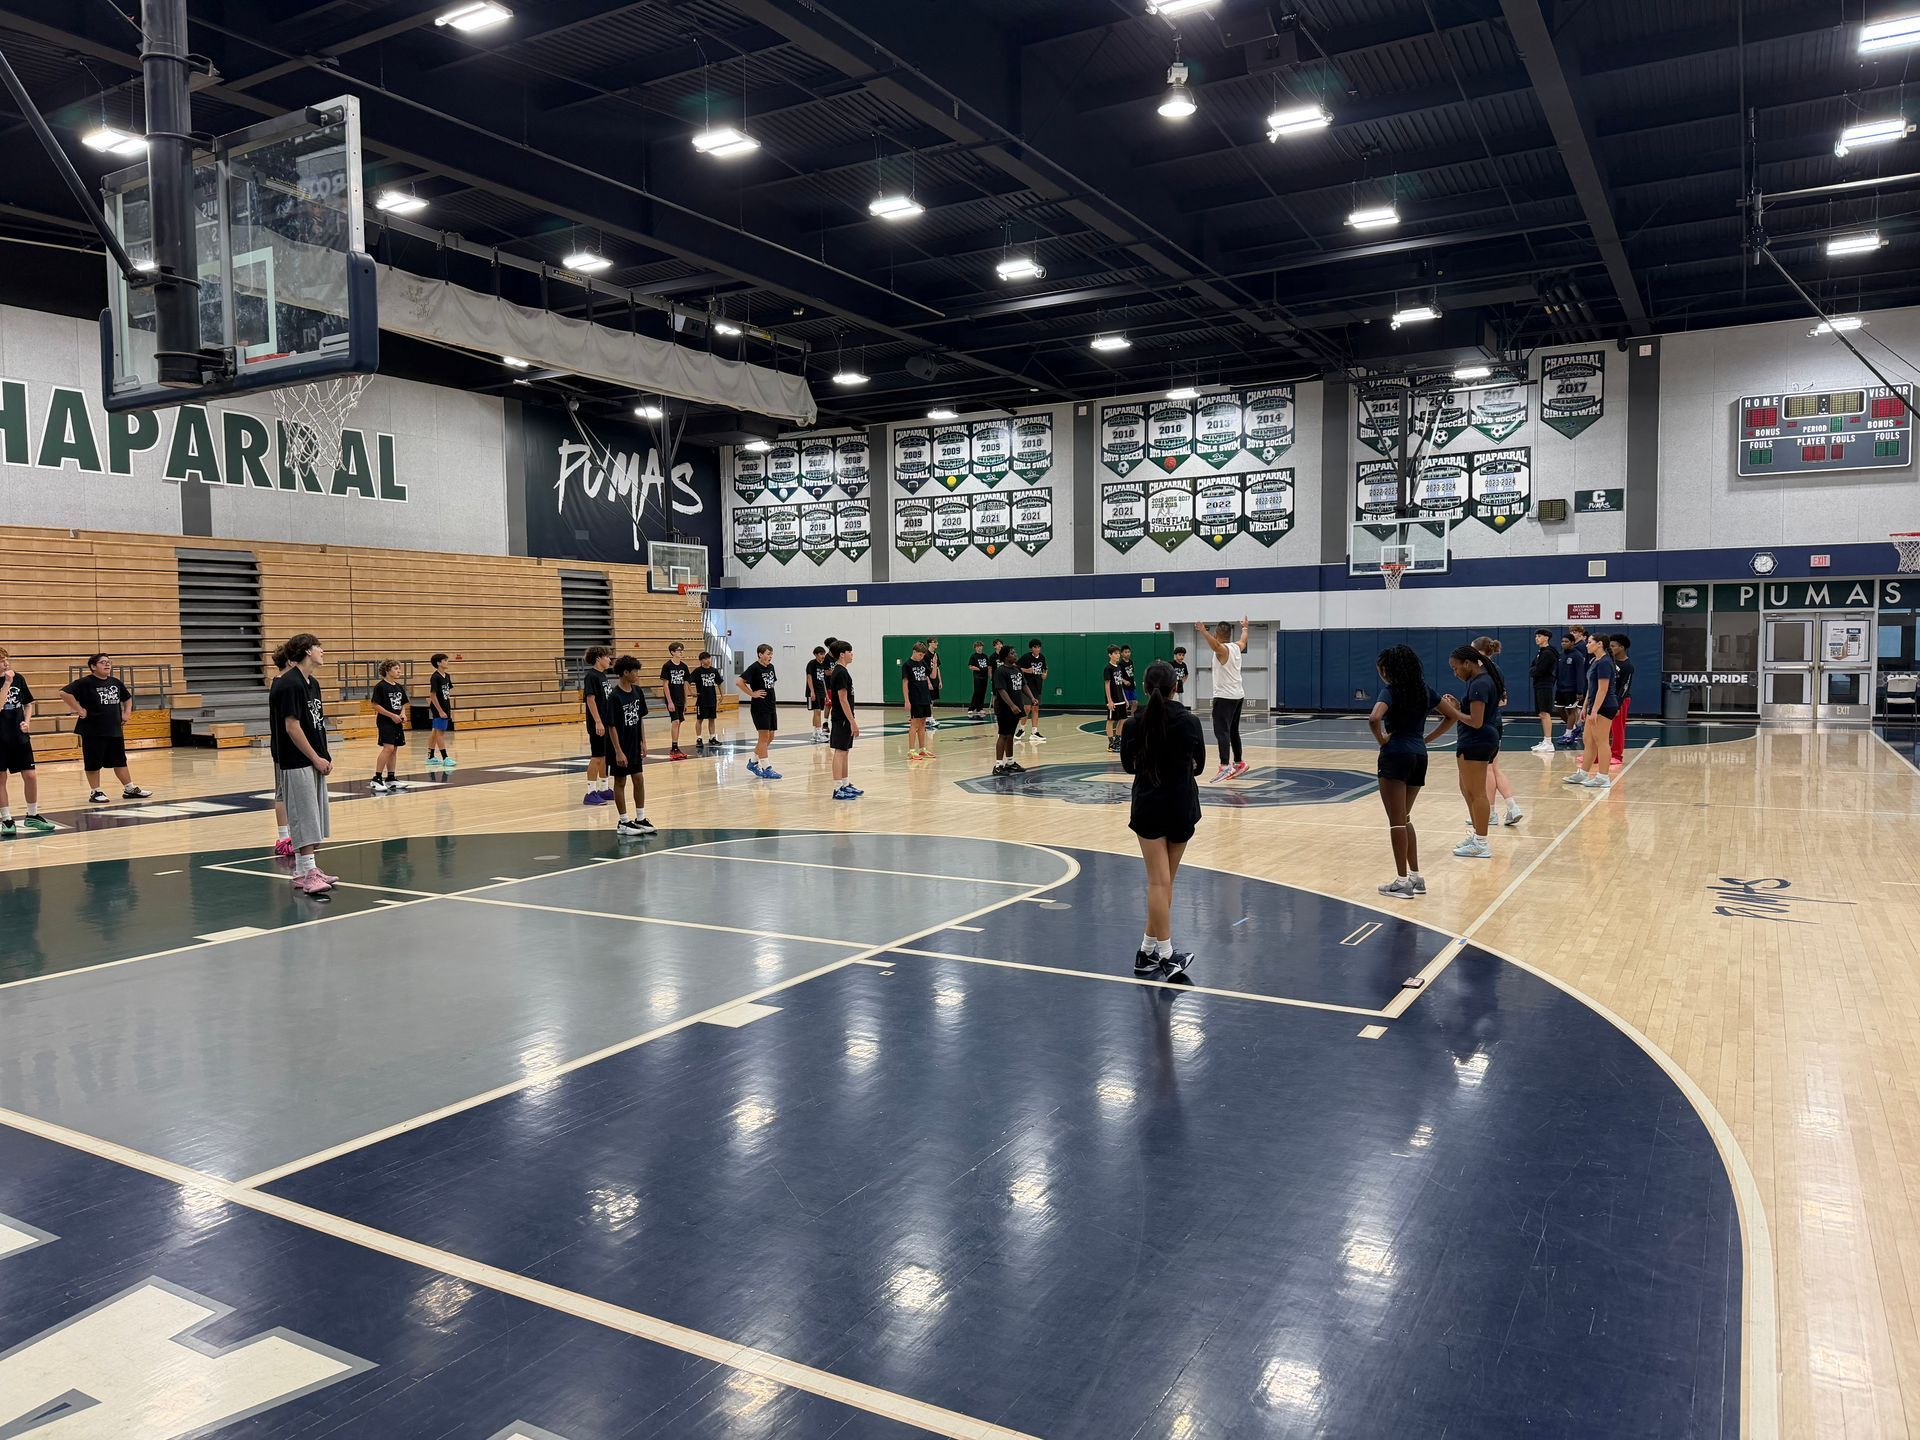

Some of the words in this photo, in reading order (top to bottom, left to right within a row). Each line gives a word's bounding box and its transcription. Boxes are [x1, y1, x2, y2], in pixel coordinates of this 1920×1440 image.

[1545, 354, 1601, 372] CHAPARRAL
[1557, 382, 1588, 394] 2017
[1246, 387, 1293, 402] CHAPARRAL
[1483, 389, 1515, 400] 2017
[1149, 400, 1192, 415] CHAPARRAL
[1197, 394, 1241, 410] CHAPARRAL
[1372, 402, 1399, 412] 2014
[1745, 397, 1779, 408] HOME
[1103, 405, 1144, 420] CHAPARRAL
[1543, 407, 1570, 419] GIRLS
[1571, 403, 1601, 416] SWIM
[1013, 415, 1050, 428] CHAPARRAL
[1257, 413, 1282, 424] 2014
[1439, 416, 1468, 428] SOCCER
[1471, 415, 1493, 425] BOYS
[1495, 411, 1526, 422] SOCCER
[973, 420, 1008, 434] CHAPARRAL
[1159, 425, 1182, 434] 2010
[1802, 425, 1828, 433] PERIOD
[1867, 420, 1894, 429] BONUS
[934, 425, 969, 438] CHAPARRAL
[1113, 429, 1135, 439] 2010
[1755, 428, 1780, 437] BONUS
[1875, 432, 1900, 441] FOULS
[1022, 440, 1042, 448] 2010
[1197, 443, 1217, 454] GIRLS
[1219, 438, 1241, 452] SWIM
[1246, 438, 1264, 449] BOYS
[1265, 434, 1292, 447] SOCCER
[1749, 441, 1773, 449] FOULS
[1797, 437, 1826, 446] PLAYER
[1831, 435, 1856, 444] FOULS
[942, 447, 961, 456] 2009
[981, 443, 1000, 452] 2009
[904, 451, 922, 459] 2009
[1103, 451, 1119, 462] BOYS
[1120, 449, 1144, 461] SOCCER
[1474, 450, 1528, 467] CHAPARRAL
[1032, 457, 1050, 468] SWIM
[1481, 460, 1521, 475] CIF
[836, 474, 869, 484] FOOTBALL
[896, 469, 930, 480] FOOTBALL
[1246, 471, 1292, 486] CHAPARRAL
[735, 480, 765, 490] FOOTBALL
[801, 477, 833, 487] FOOTBALL
[1149, 480, 1192, 493] CHAPARRAL
[1197, 475, 1241, 491] CHAPARRAL
[553, 439, 704, 551] PUMAS
[1013, 489, 1050, 502] CHAPARRAL
[1103, 483, 1144, 497] CHAPARRAL
[973, 492, 1009, 505] CHAPARRAL
[1592, 490, 1606, 503] C
[1206, 501, 1231, 509] 2022
[1021, 512, 1041, 520] 2021
[1112, 507, 1133, 516] 2021
[904, 518, 923, 527] 2019
[942, 518, 962, 526] 2020
[981, 514, 1000, 523] 2021
[1152, 517, 1170, 525] GIRLS
[1172, 516, 1189, 525] FLAG
[844, 520, 862, 529] 2019
[1149, 522, 1192, 533] FOOTBALL
[1249, 519, 1289, 532] WRESTLING
[1104, 529, 1118, 538] BOYS
[1118, 527, 1144, 537] LACROSSE
[897, 539, 913, 547] BOYS
[914, 537, 931, 546] GOLF
[1813, 556, 1828, 566] EXIT
[1740, 582, 1902, 607] PUMAS
[1671, 674, 1709, 684] PUMA
[1711, 674, 1748, 684] PRIDE
[1836, 705, 1850, 715] EXIT
